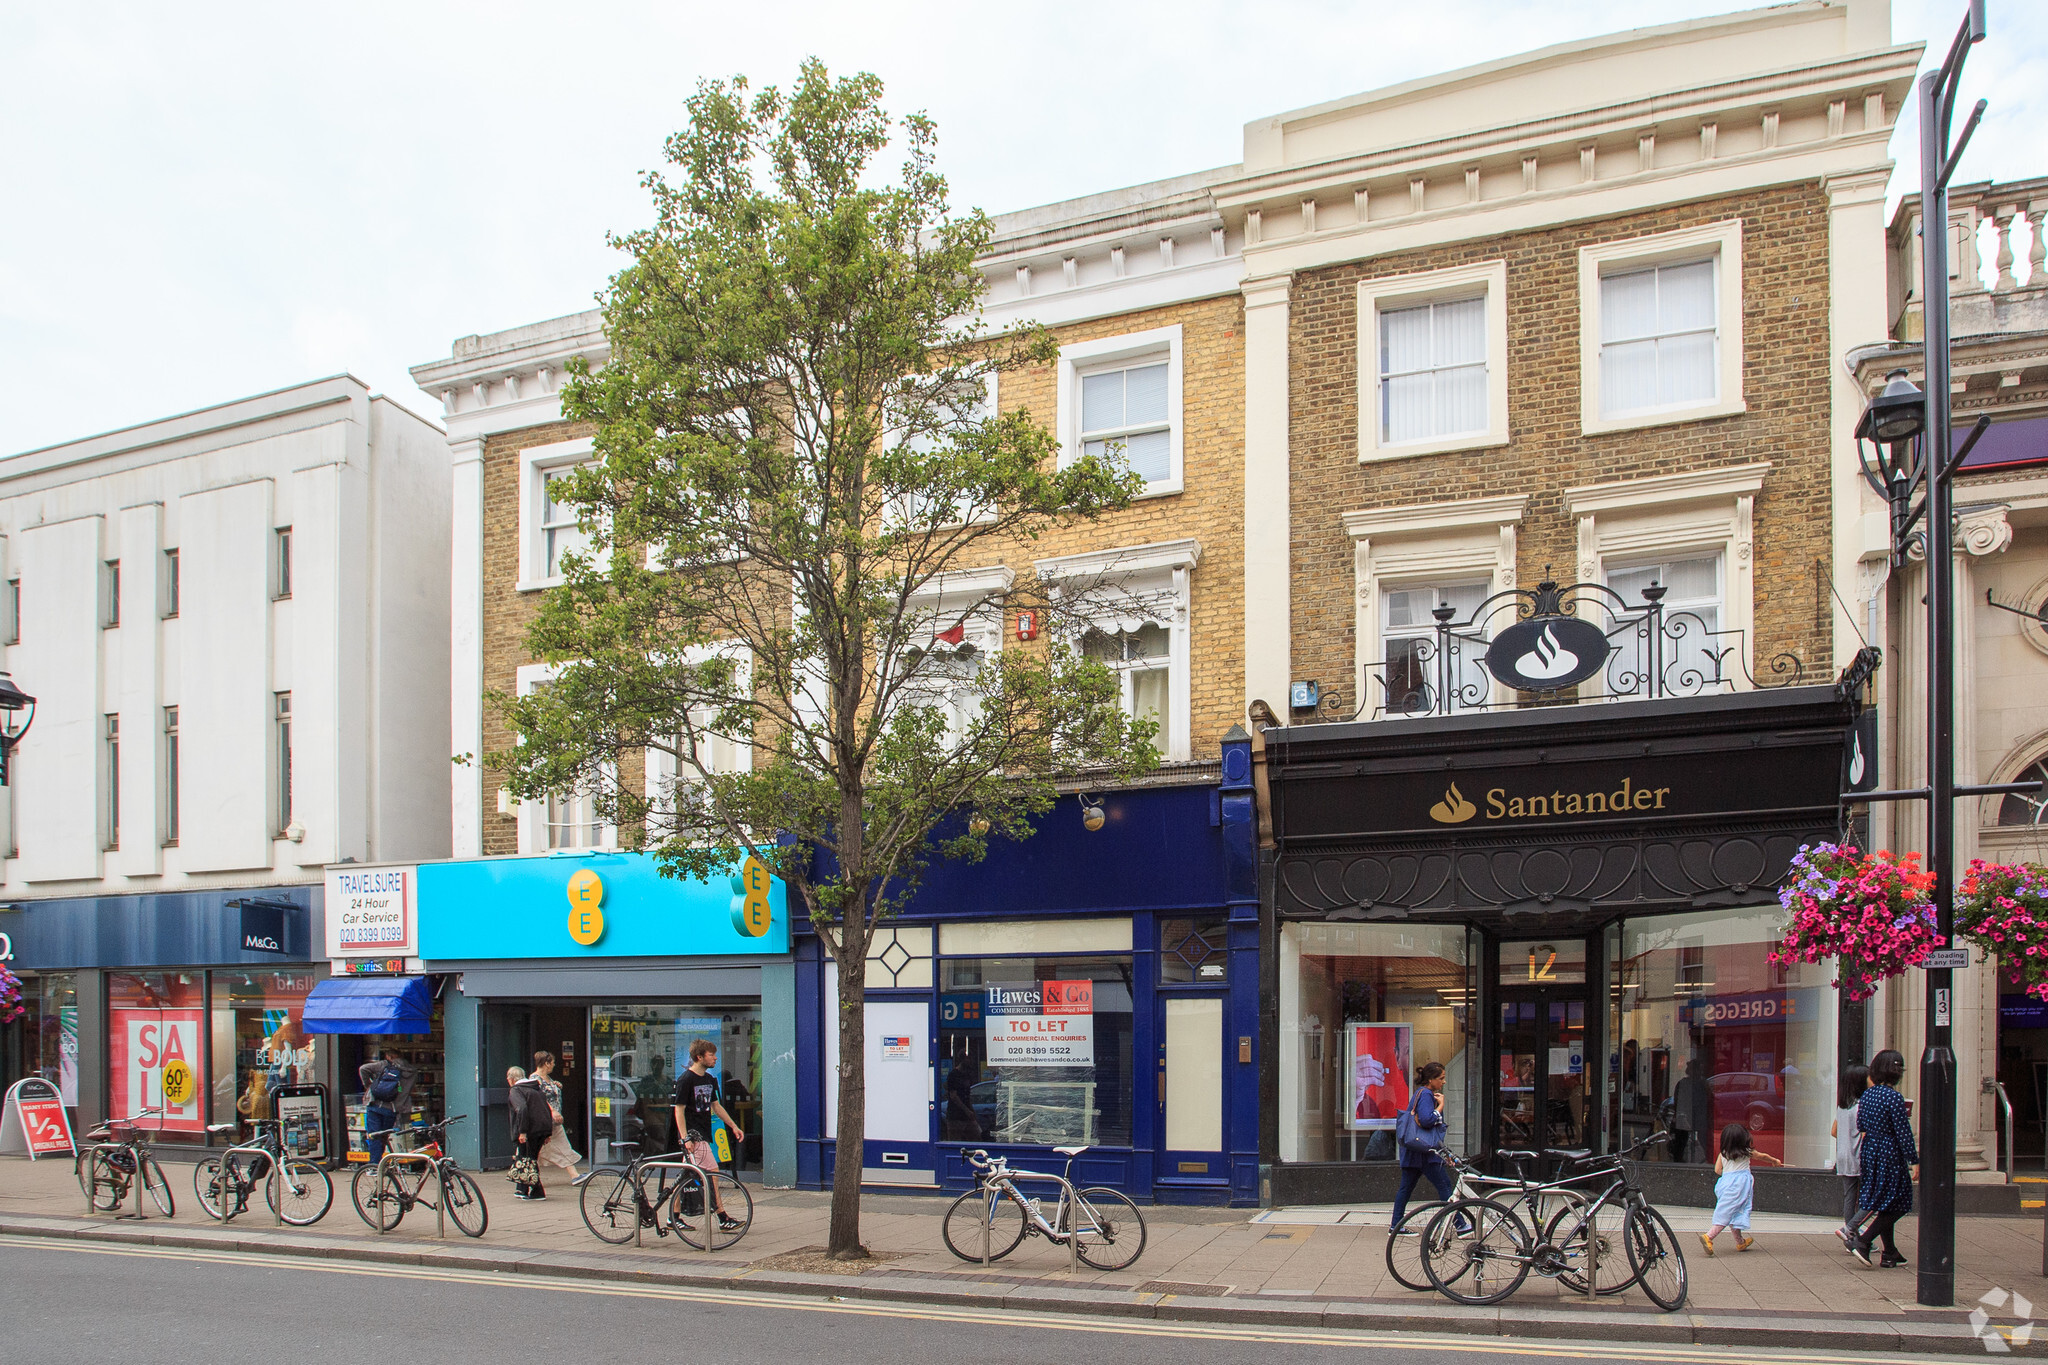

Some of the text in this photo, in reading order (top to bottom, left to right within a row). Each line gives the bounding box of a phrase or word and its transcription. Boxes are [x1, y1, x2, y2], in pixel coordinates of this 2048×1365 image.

[1486, 776, 1671, 820] Santander
[338, 872, 401, 894] TRAVELSURE
[351, 898, 390, 909] 24 Hour
[342, 912, 399, 924] Car Service
[245, 934, 279, 950] M&Co.
[340, 926, 402, 942] 020 8399 0399
[1527, 944, 1557, 982] 12
[1937, 952, 1965, 960] loading
[988, 985, 1090, 1004] Hawes & Co
[1009, 1020, 1068, 1032] TO LET
[256, 1049, 308, 1066] BE BOLD
[166, 1086, 182, 1098] OFF
[27, 1112, 64, 1140] 1/2
[56, 1140, 70, 1148] PRICE
